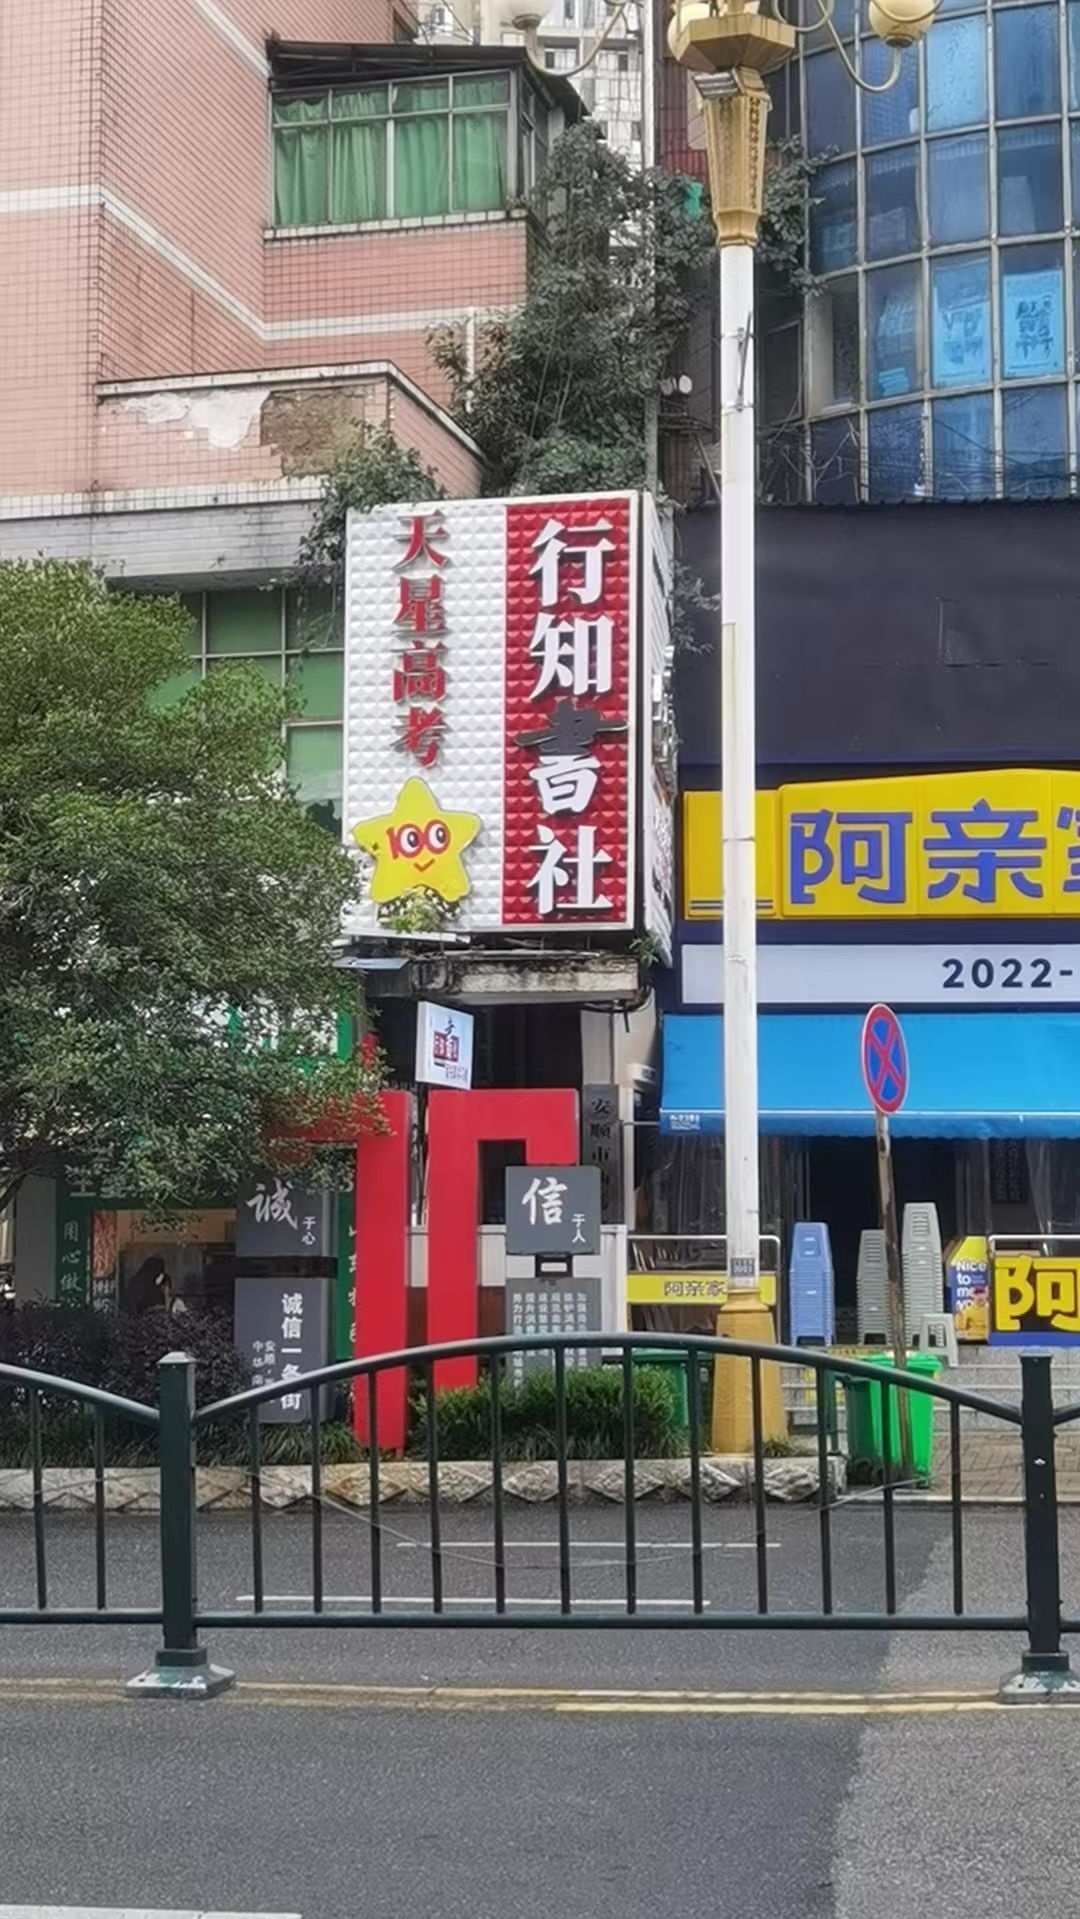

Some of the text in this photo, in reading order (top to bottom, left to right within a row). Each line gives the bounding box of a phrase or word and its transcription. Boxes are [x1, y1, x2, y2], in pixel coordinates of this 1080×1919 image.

[391, 509, 449, 770] 天星高考
[790, 798, 1080, 904] 阿亲
[942, 958, 1073, 989] 2022-
[245, 1178, 299, 1231] 诚
[521, 1176, 568, 1226] 信
[301, 1215, 317, 1246] 于心
[571, 1213, 587, 1244] 于人
[956, 1271, 973, 1287] to
